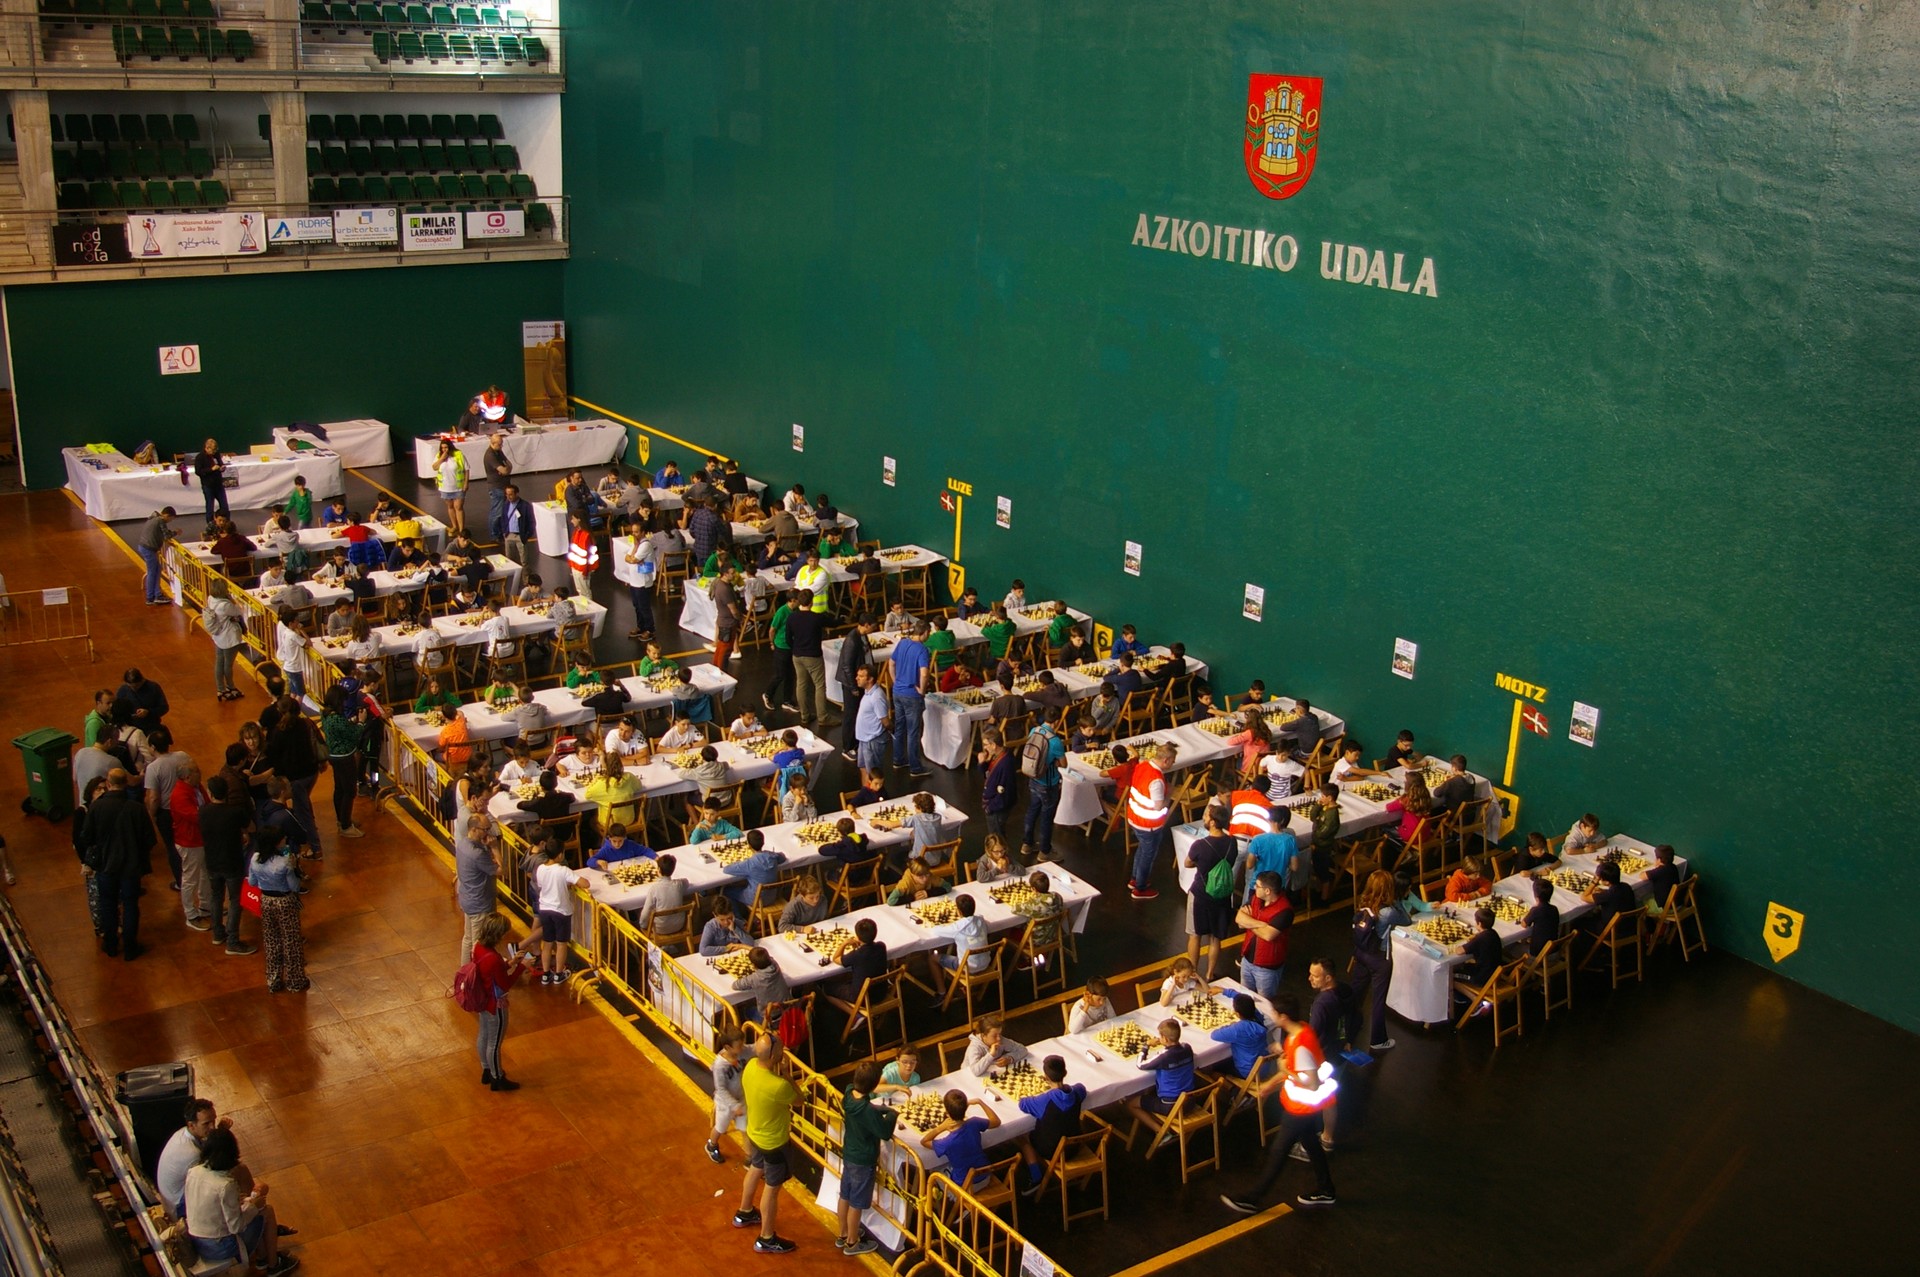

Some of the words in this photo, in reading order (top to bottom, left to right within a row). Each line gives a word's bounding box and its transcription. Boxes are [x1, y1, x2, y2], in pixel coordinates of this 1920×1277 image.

[297, 219, 331, 229] ALDAPE
[422, 216, 455, 228] MILAR
[410, 228, 456, 237] LARRAMENDI
[1131, 213, 1298, 272] AZKOITIKO
[1320, 241, 1438, 298] UDALA
[640, 439, 649, 453] 10
[947, 477, 972, 496] LUZE
[952, 568, 961, 585] 7
[1097, 630, 1108, 647] 6
[1495, 672, 1547, 703] MOTZ
[1499, 797, 1511, 819] 4
[1772, 912, 1794, 939] 3
